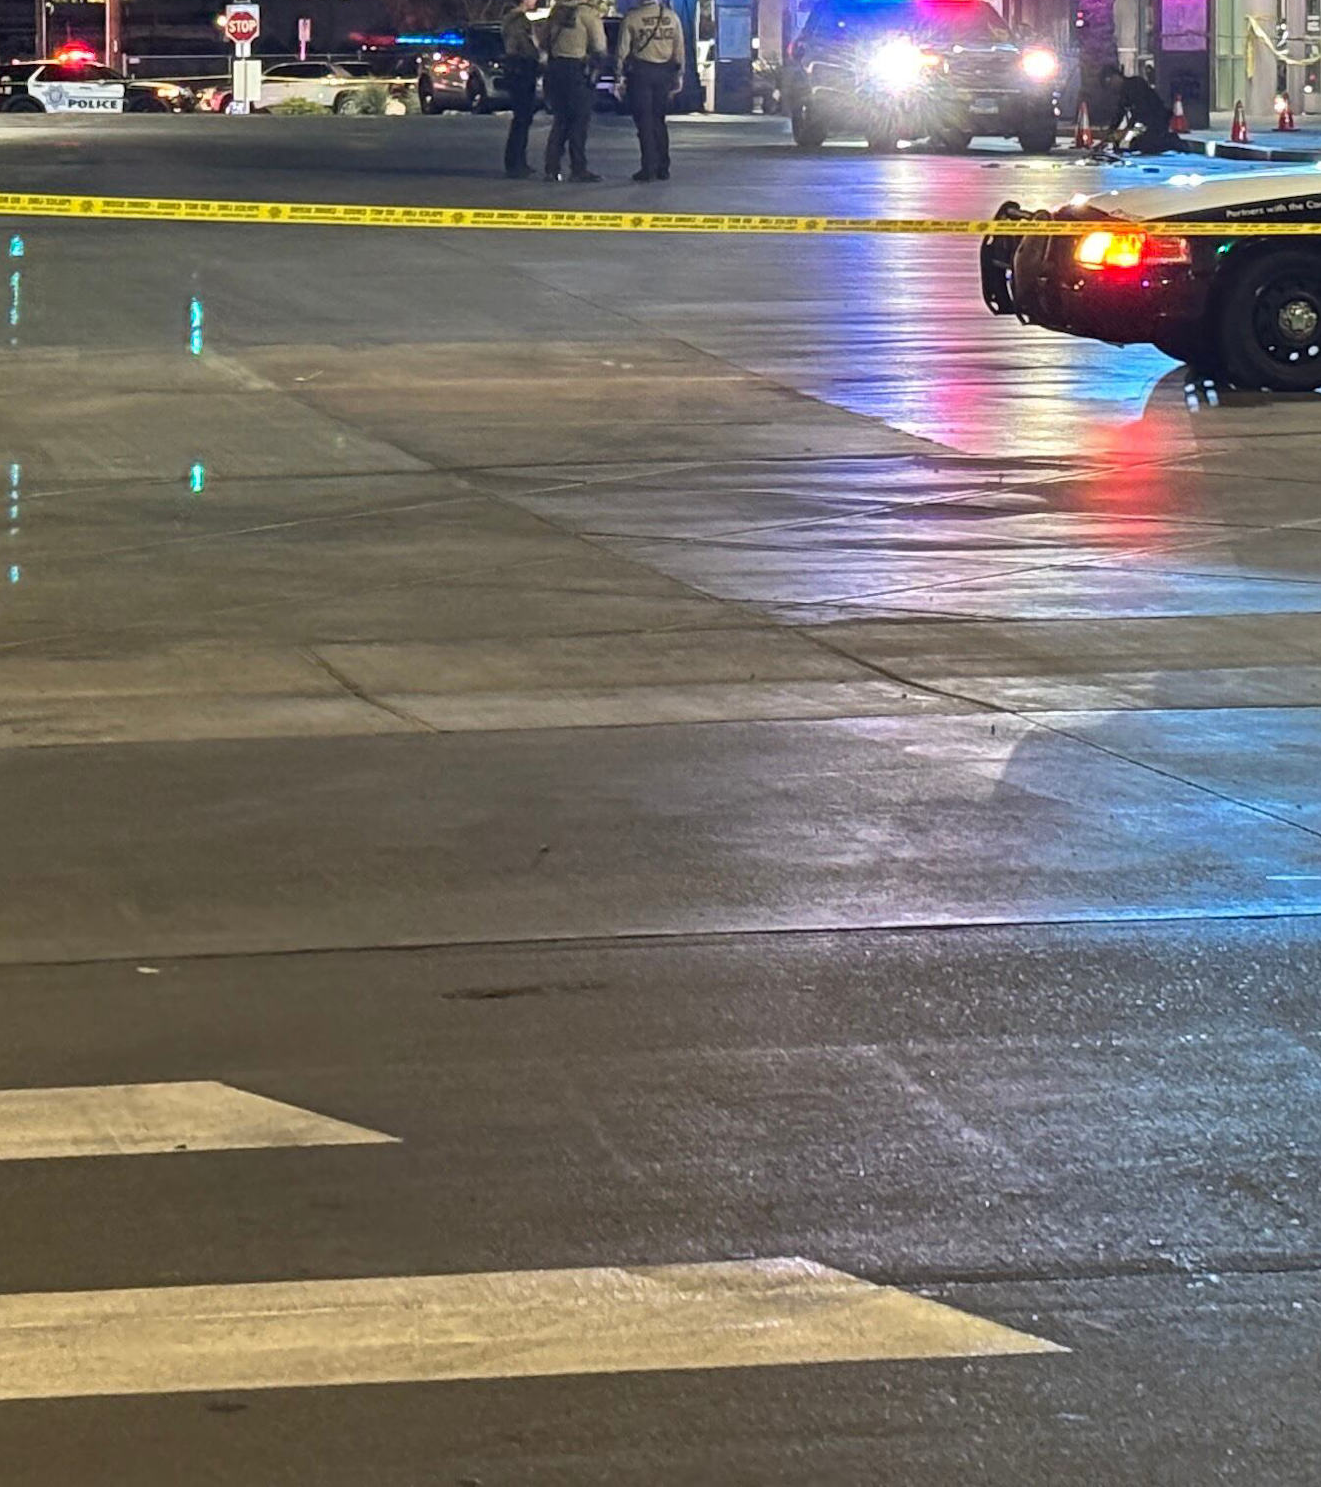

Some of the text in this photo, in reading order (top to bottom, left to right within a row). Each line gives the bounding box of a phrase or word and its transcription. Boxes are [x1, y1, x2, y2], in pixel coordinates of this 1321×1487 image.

[228, 19, 257, 33] STOP
[639, 28, 674, 40] POLICE
[68, 98, 118, 109] POLICE
[1226, 207, 1264, 218] Partners
[1265, 205, 1287, 214] with
[1288, 202, 1304, 211] the
